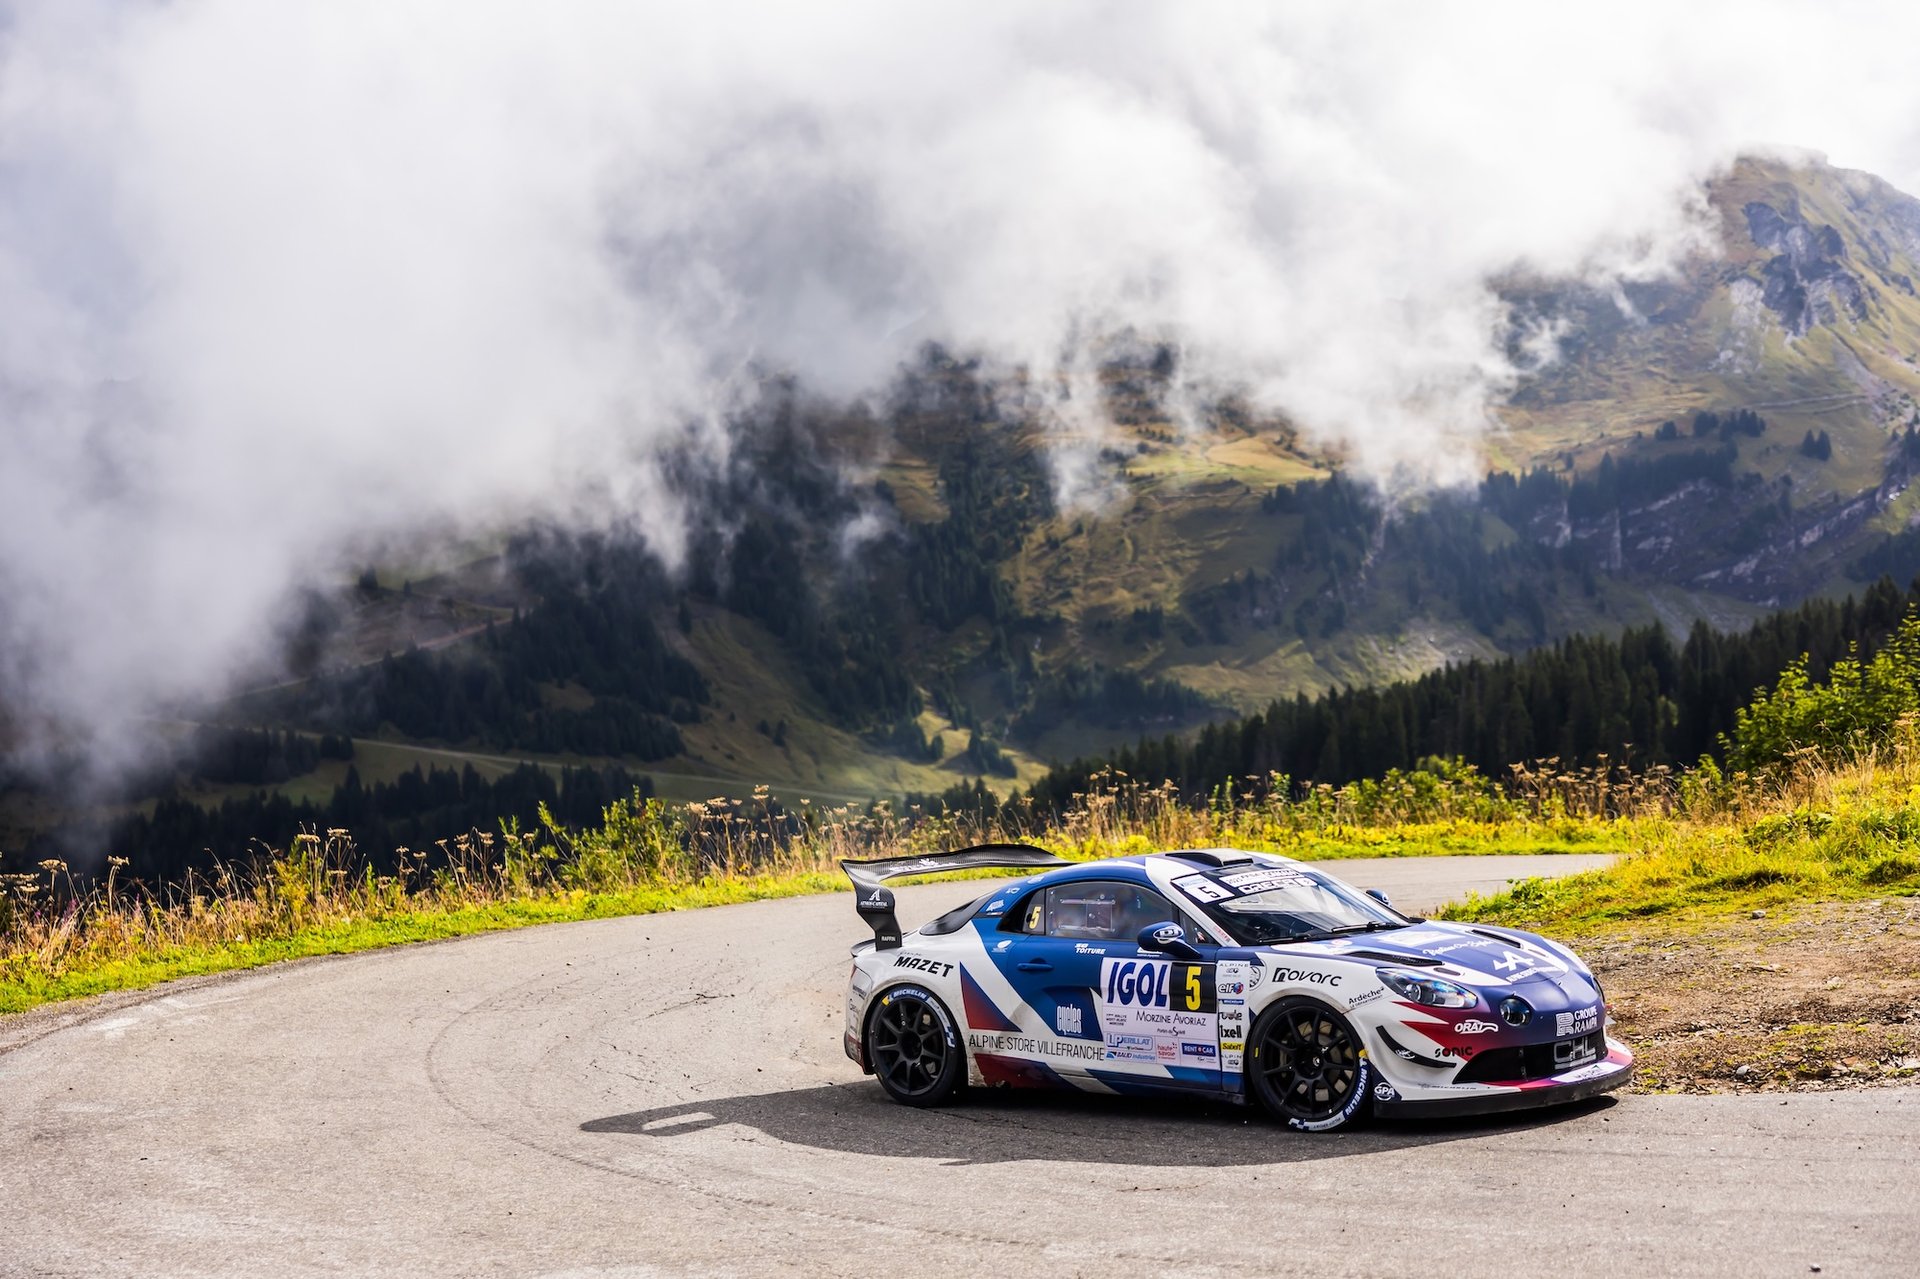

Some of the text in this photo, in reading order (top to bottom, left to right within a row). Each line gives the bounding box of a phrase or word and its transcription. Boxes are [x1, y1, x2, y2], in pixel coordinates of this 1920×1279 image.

[1029, 906, 1042, 929] 5
[1076, 947, 1106, 955] TOITURE
[893, 956, 954, 978] MAZET
[1107, 961, 1168, 1007] IGOL
[1185, 965, 1202, 1011] 5
[893, 988, 928, 1000] MICHELIN
[1349, 989, 1382, 1004] Ardèche
[1136, 1010, 1171, 1023] MORZINE
[1173, 1013, 1206, 1026] AVORIAZ
[1574, 1006, 1598, 1021] GROUPE
[1574, 1016, 1598, 1034] RAMPA
[969, 1034, 1104, 1061] ALPINE STORE VILLEFRANCHE
[1345, 1068, 1368, 1115] MICHELIN
[1374, 1086, 1395, 1097] GPA
